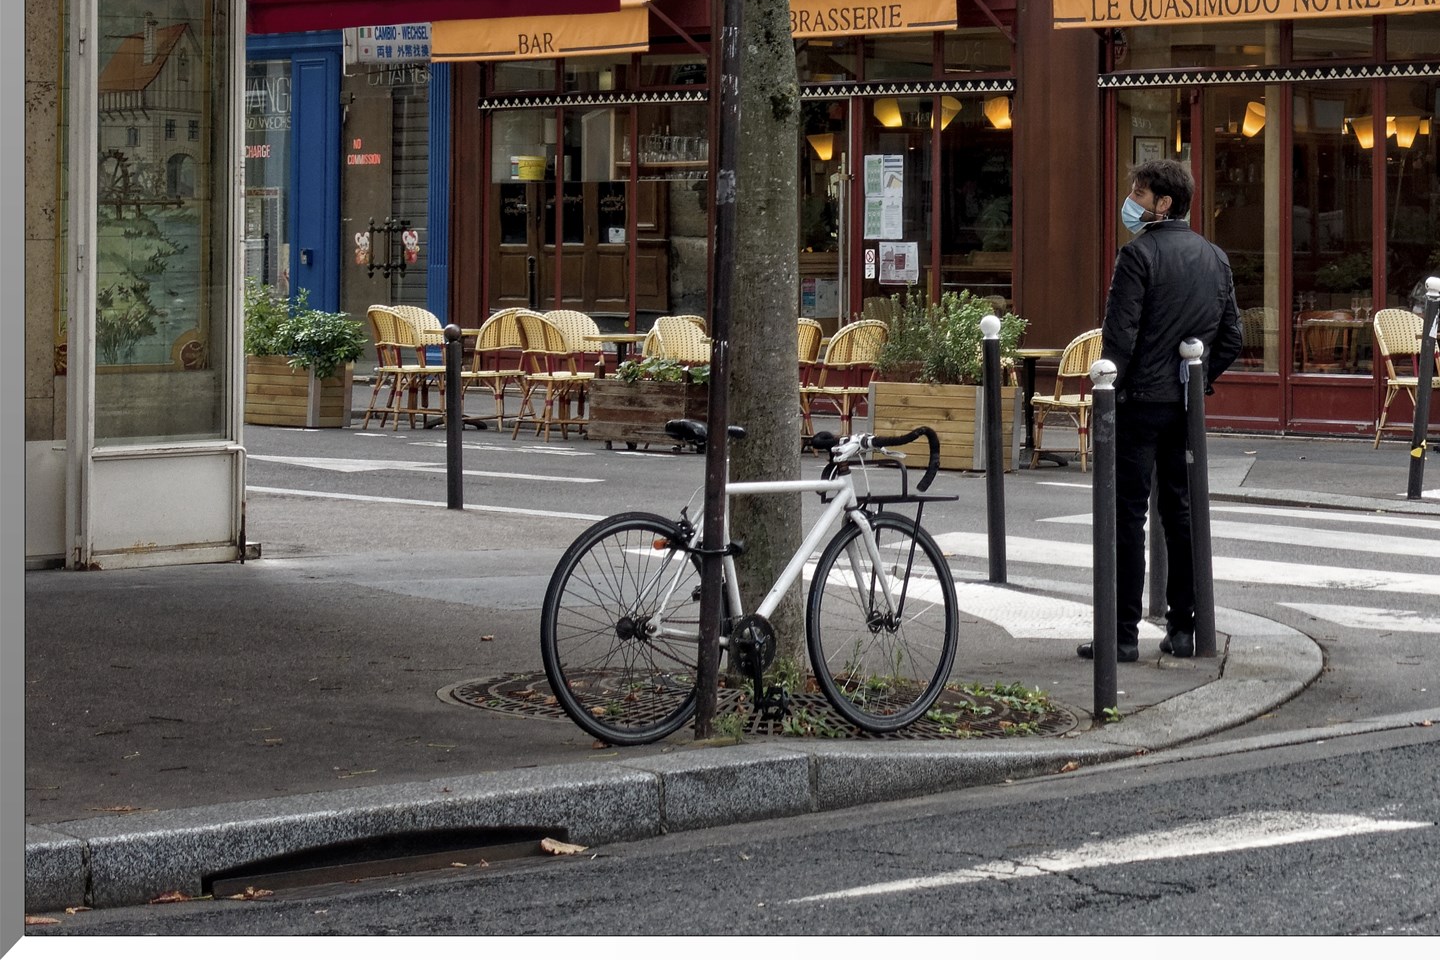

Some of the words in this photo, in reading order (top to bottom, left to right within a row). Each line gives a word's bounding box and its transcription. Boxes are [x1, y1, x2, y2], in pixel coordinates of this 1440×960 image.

[790, 4, 903, 33] BRASSERIE
[375, 26, 396, 41] CAMBIO
[402, 25, 428, 40] WECHSEL
[518, 33, 554, 55] BAR
[353, 138, 362, 149] NO
[347, 153, 381, 165] COMMISSION
